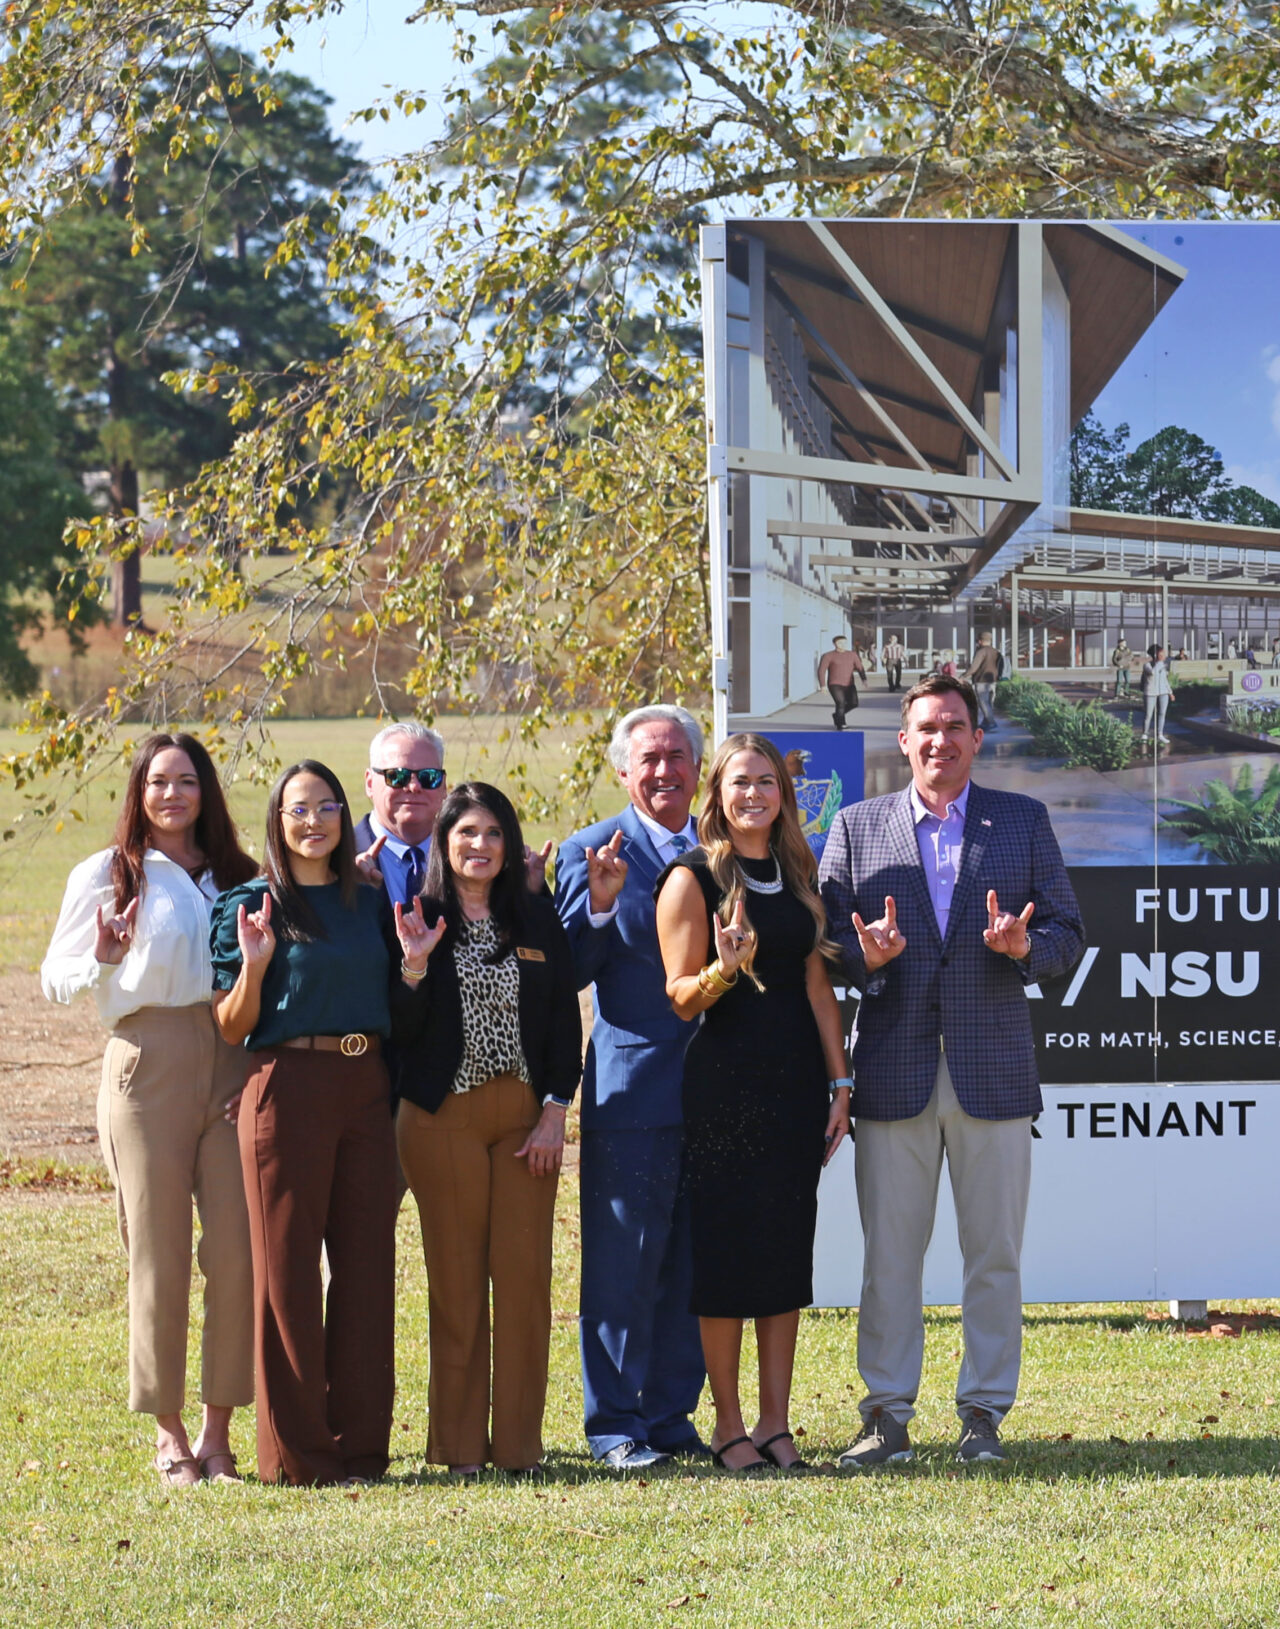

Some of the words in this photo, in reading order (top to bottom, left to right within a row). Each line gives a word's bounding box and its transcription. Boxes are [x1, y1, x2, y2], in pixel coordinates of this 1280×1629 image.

[1120, 950, 1260, 998] NSU
[1045, 1032, 1091, 1049] FOR
[1100, 1031, 1169, 1049] MATH,
[1056, 1100, 1257, 1139] TENANT
